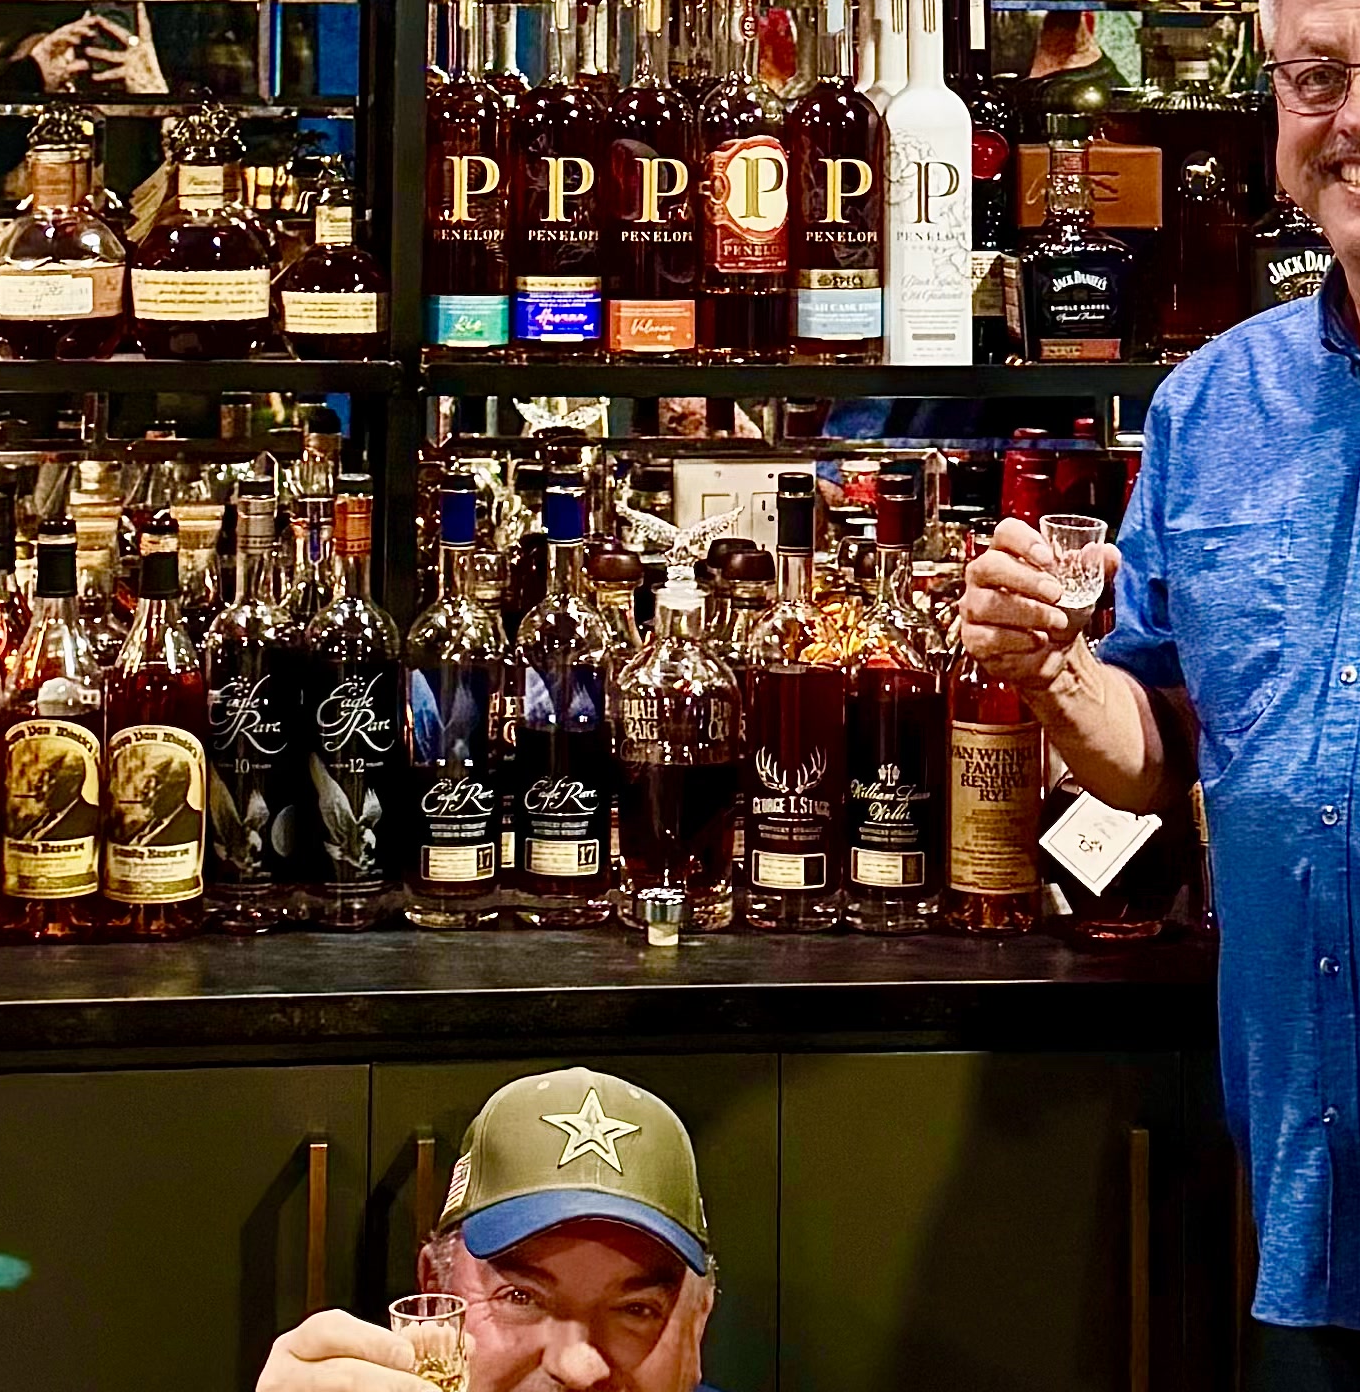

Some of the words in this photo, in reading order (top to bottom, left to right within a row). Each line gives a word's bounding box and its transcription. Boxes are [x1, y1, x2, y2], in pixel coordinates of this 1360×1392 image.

[445, 155, 500, 223] P
[539, 157, 595, 223] P
[634, 157, 689, 223] P
[738, 156, 784, 219] P
[818, 158, 873, 224] P
[912, 161, 960, 224] P
[723, 243, 784, 257] PENELO
[1052, 275, 1074, 293] JACK
[1268, 255, 1304, 285] JACK
[317, 673, 383, 735] Eagle
[216, 710, 288, 754] Rare
[324, 709, 395, 752] Rare
[234, 758, 250, 774] 10
[349, 758, 364, 774] 12
[965, 760, 1025, 775] FAMILY
[978, 788, 1012, 802] RYE
[477, 849, 494, 870] 17
[578, 845, 596, 865] 17
